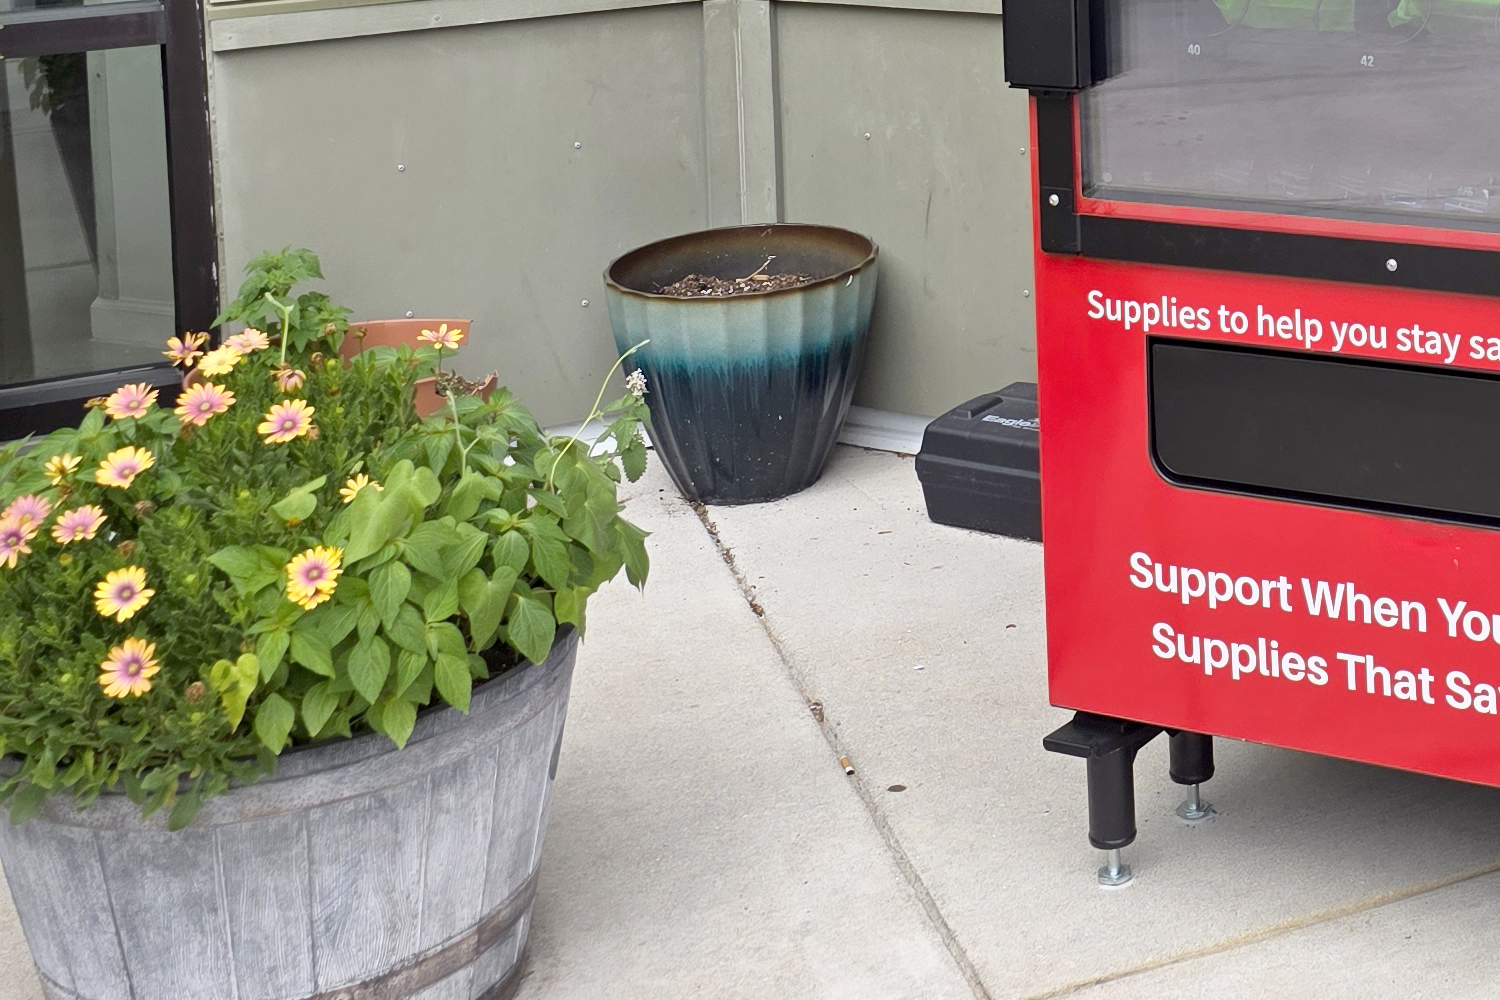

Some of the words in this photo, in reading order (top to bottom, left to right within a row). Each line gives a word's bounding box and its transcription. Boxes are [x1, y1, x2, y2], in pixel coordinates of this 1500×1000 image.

[1188, 44, 1201, 55] 40
[1360, 55, 1374, 67] 42
[1087, 289, 1211, 332] Supplies
[1218, 304, 1249, 335] to
[1257, 304, 1323, 349] help
[1329, 321, 1387, 352] you
[1396, 324, 1462, 364] stay
[1129, 551, 1293, 612] Support
[1301, 577, 1427, 633] When
[1152, 622, 1329, 686] Supplies
[1336, 652, 1435, 705] That
